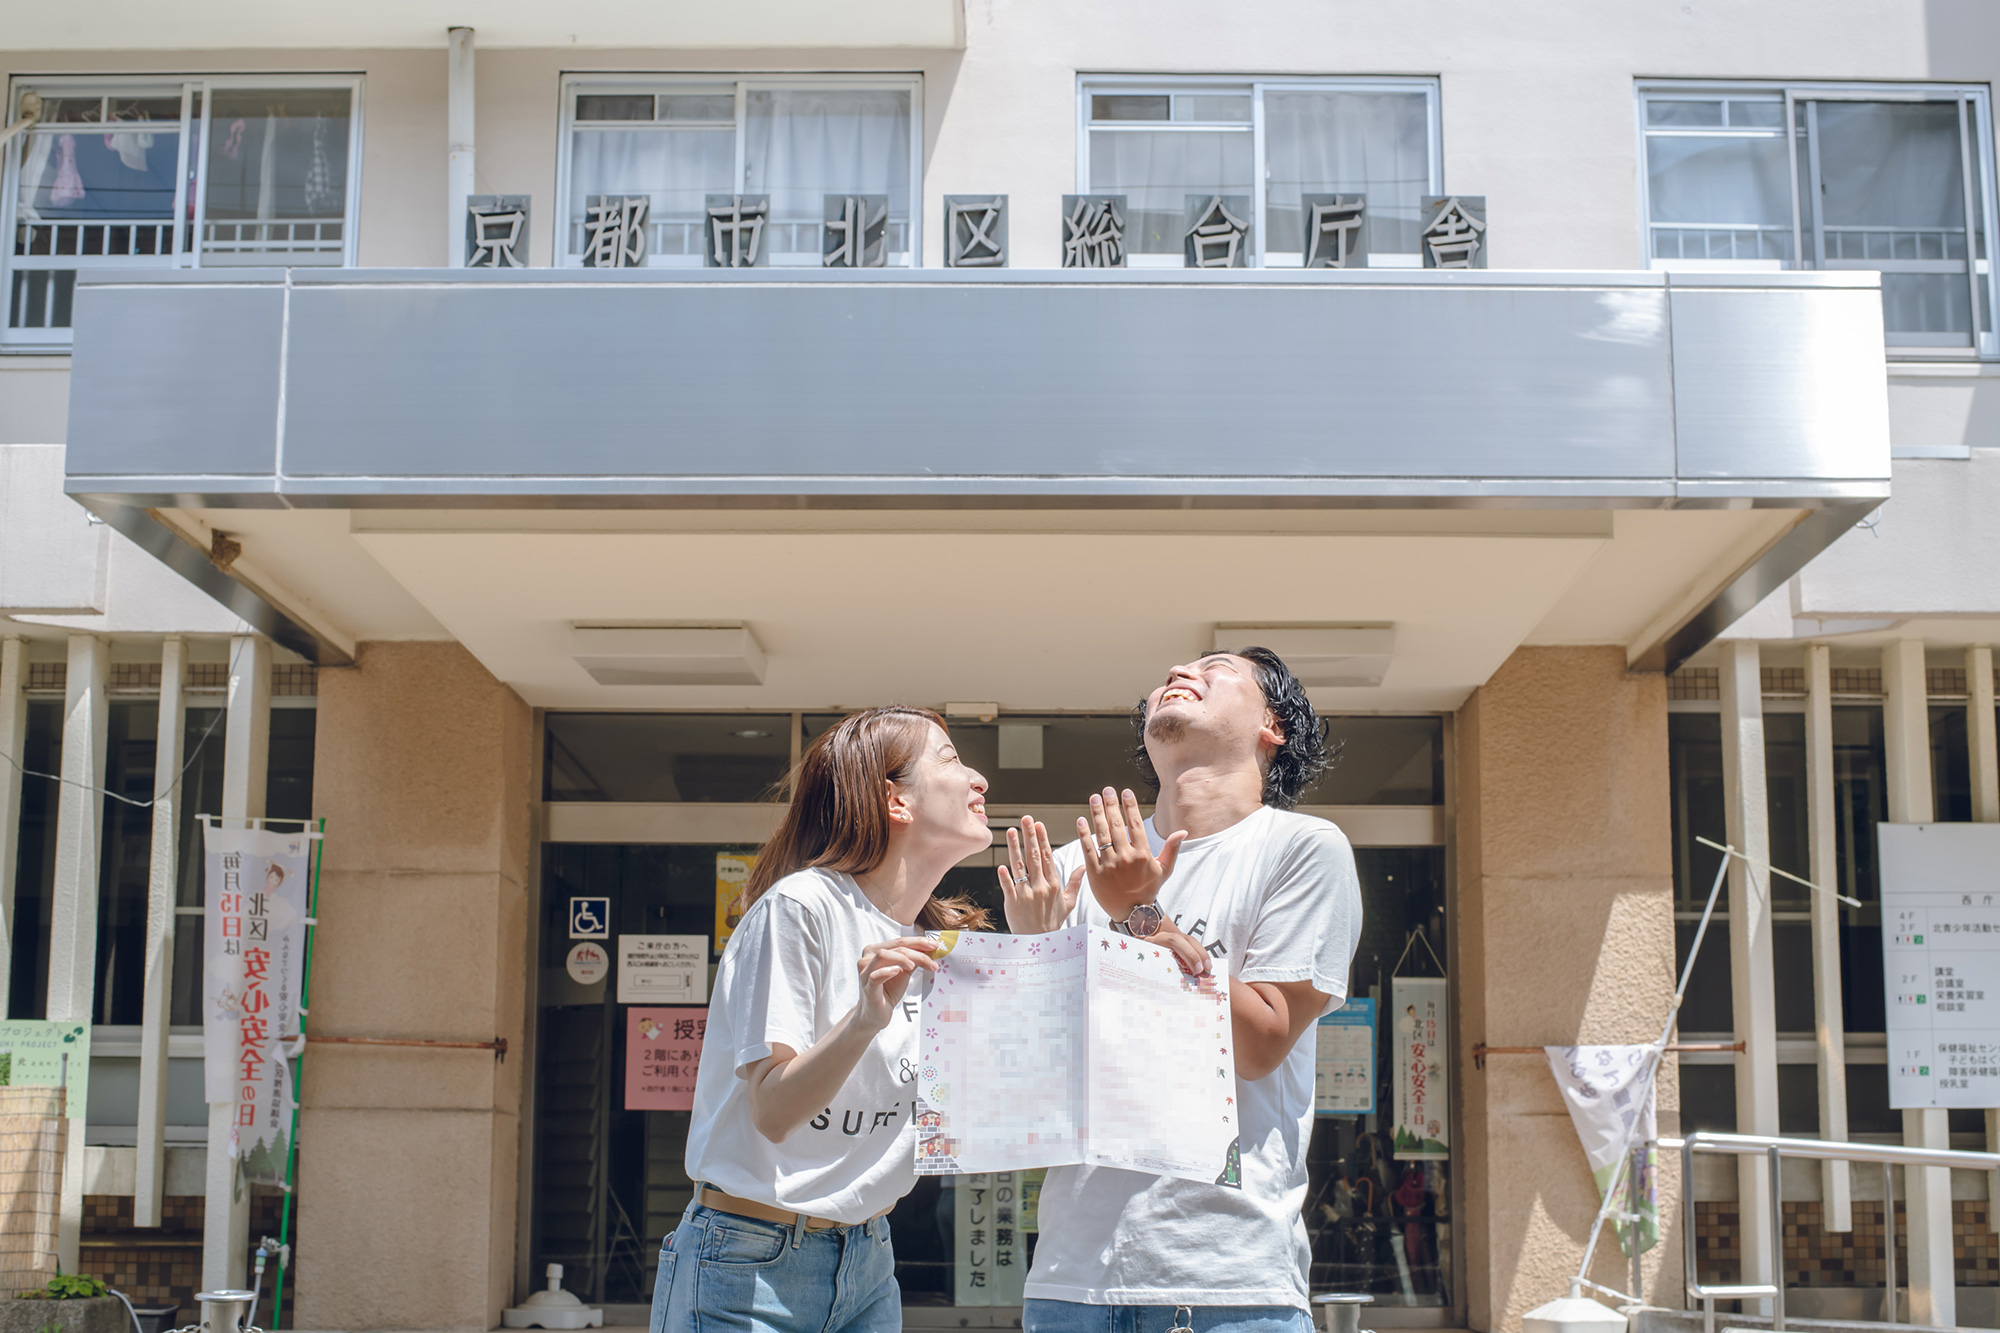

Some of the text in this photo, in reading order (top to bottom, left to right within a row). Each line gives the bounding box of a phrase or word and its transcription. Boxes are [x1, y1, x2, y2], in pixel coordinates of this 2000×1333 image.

[466, 194, 1487, 269] 京都市北区総合庁舎
[20, 1040, 58, 1049] PROJECT
[1938, 1043, 2000, 1053] 保健福祉セン
[1948, 1055, 2000, 1065] 子どもはぐ
[1948, 1067, 2000, 1076] 障害保健福
[1410, 1043, 1427, 1126] 安心安全の日
